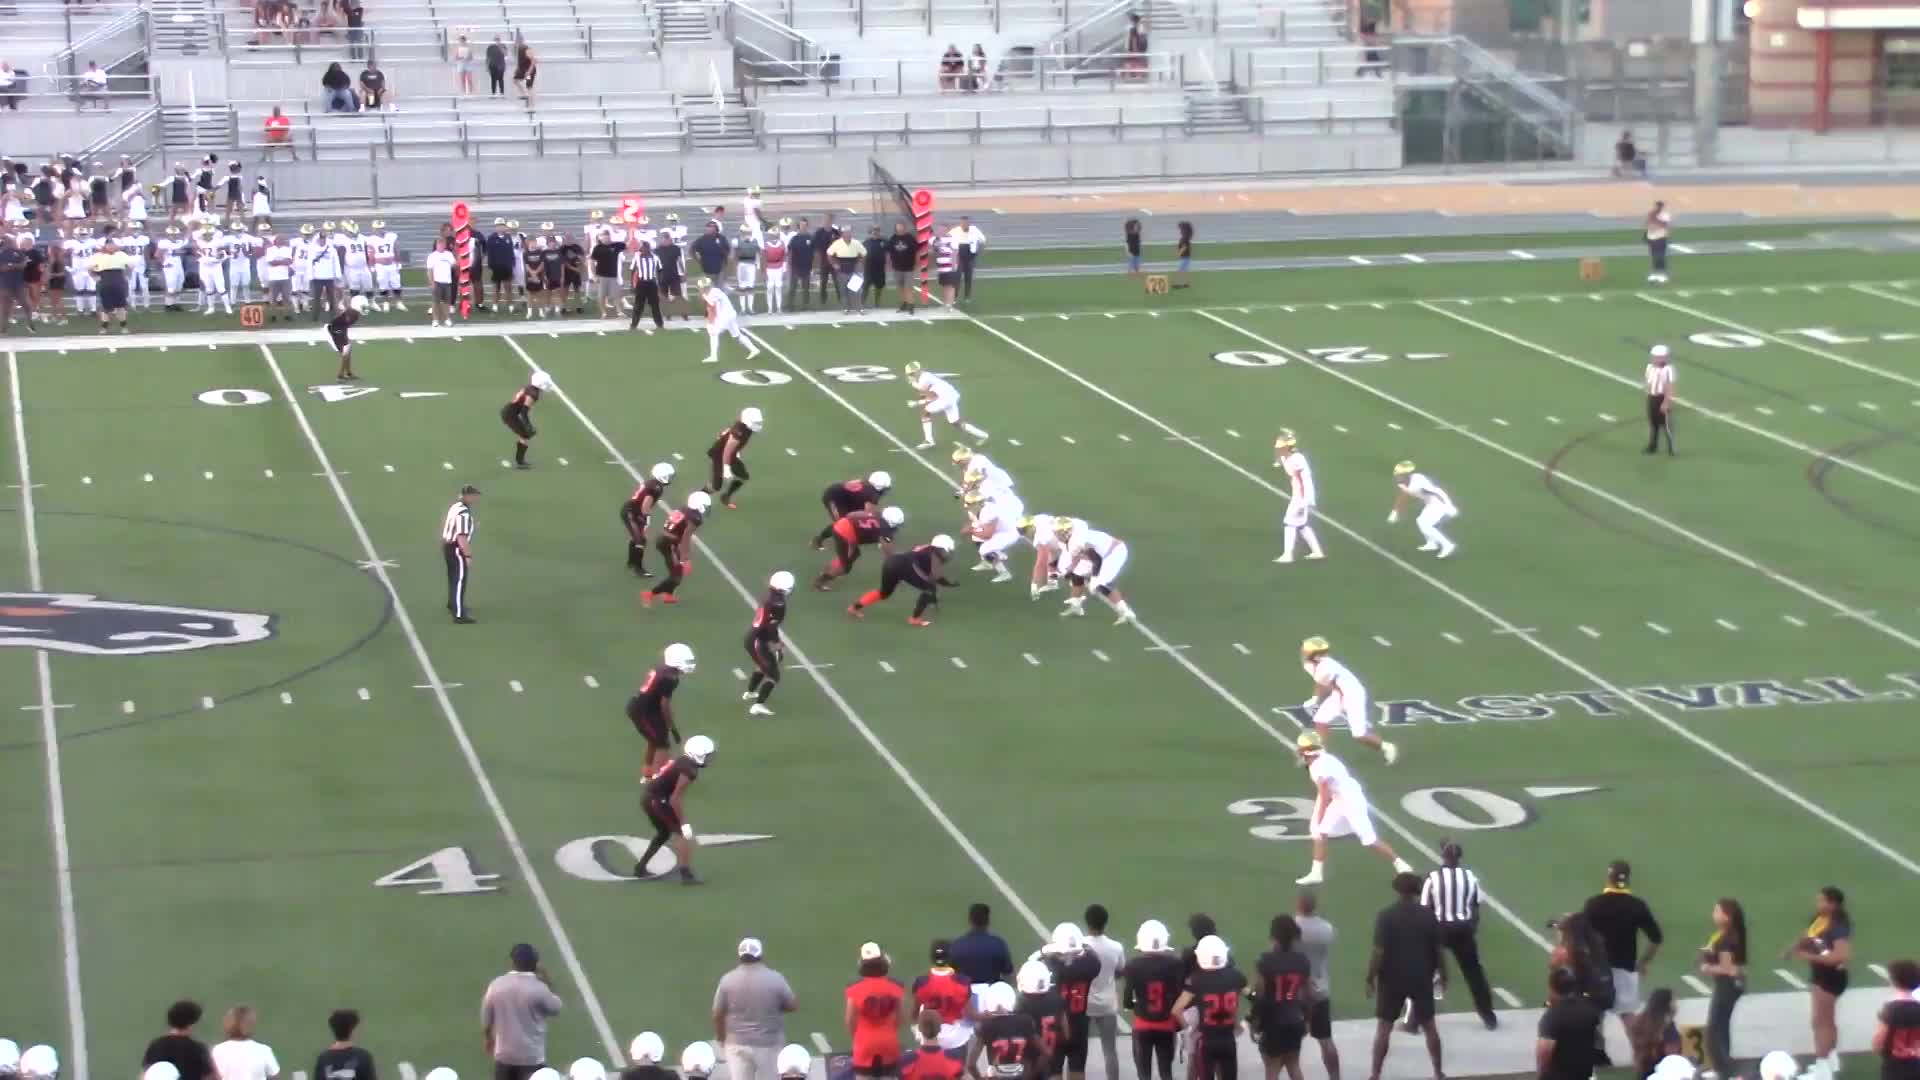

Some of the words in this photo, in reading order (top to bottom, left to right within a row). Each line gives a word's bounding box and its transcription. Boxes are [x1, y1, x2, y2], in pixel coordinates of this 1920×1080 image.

[624, 199, 640, 222] 2
[243, 307, 261, 324] 40
[373, 833, 680, 895] 40
[1203, 992, 1236, 1025] 29
[991, 1040, 1028, 1063] 27
